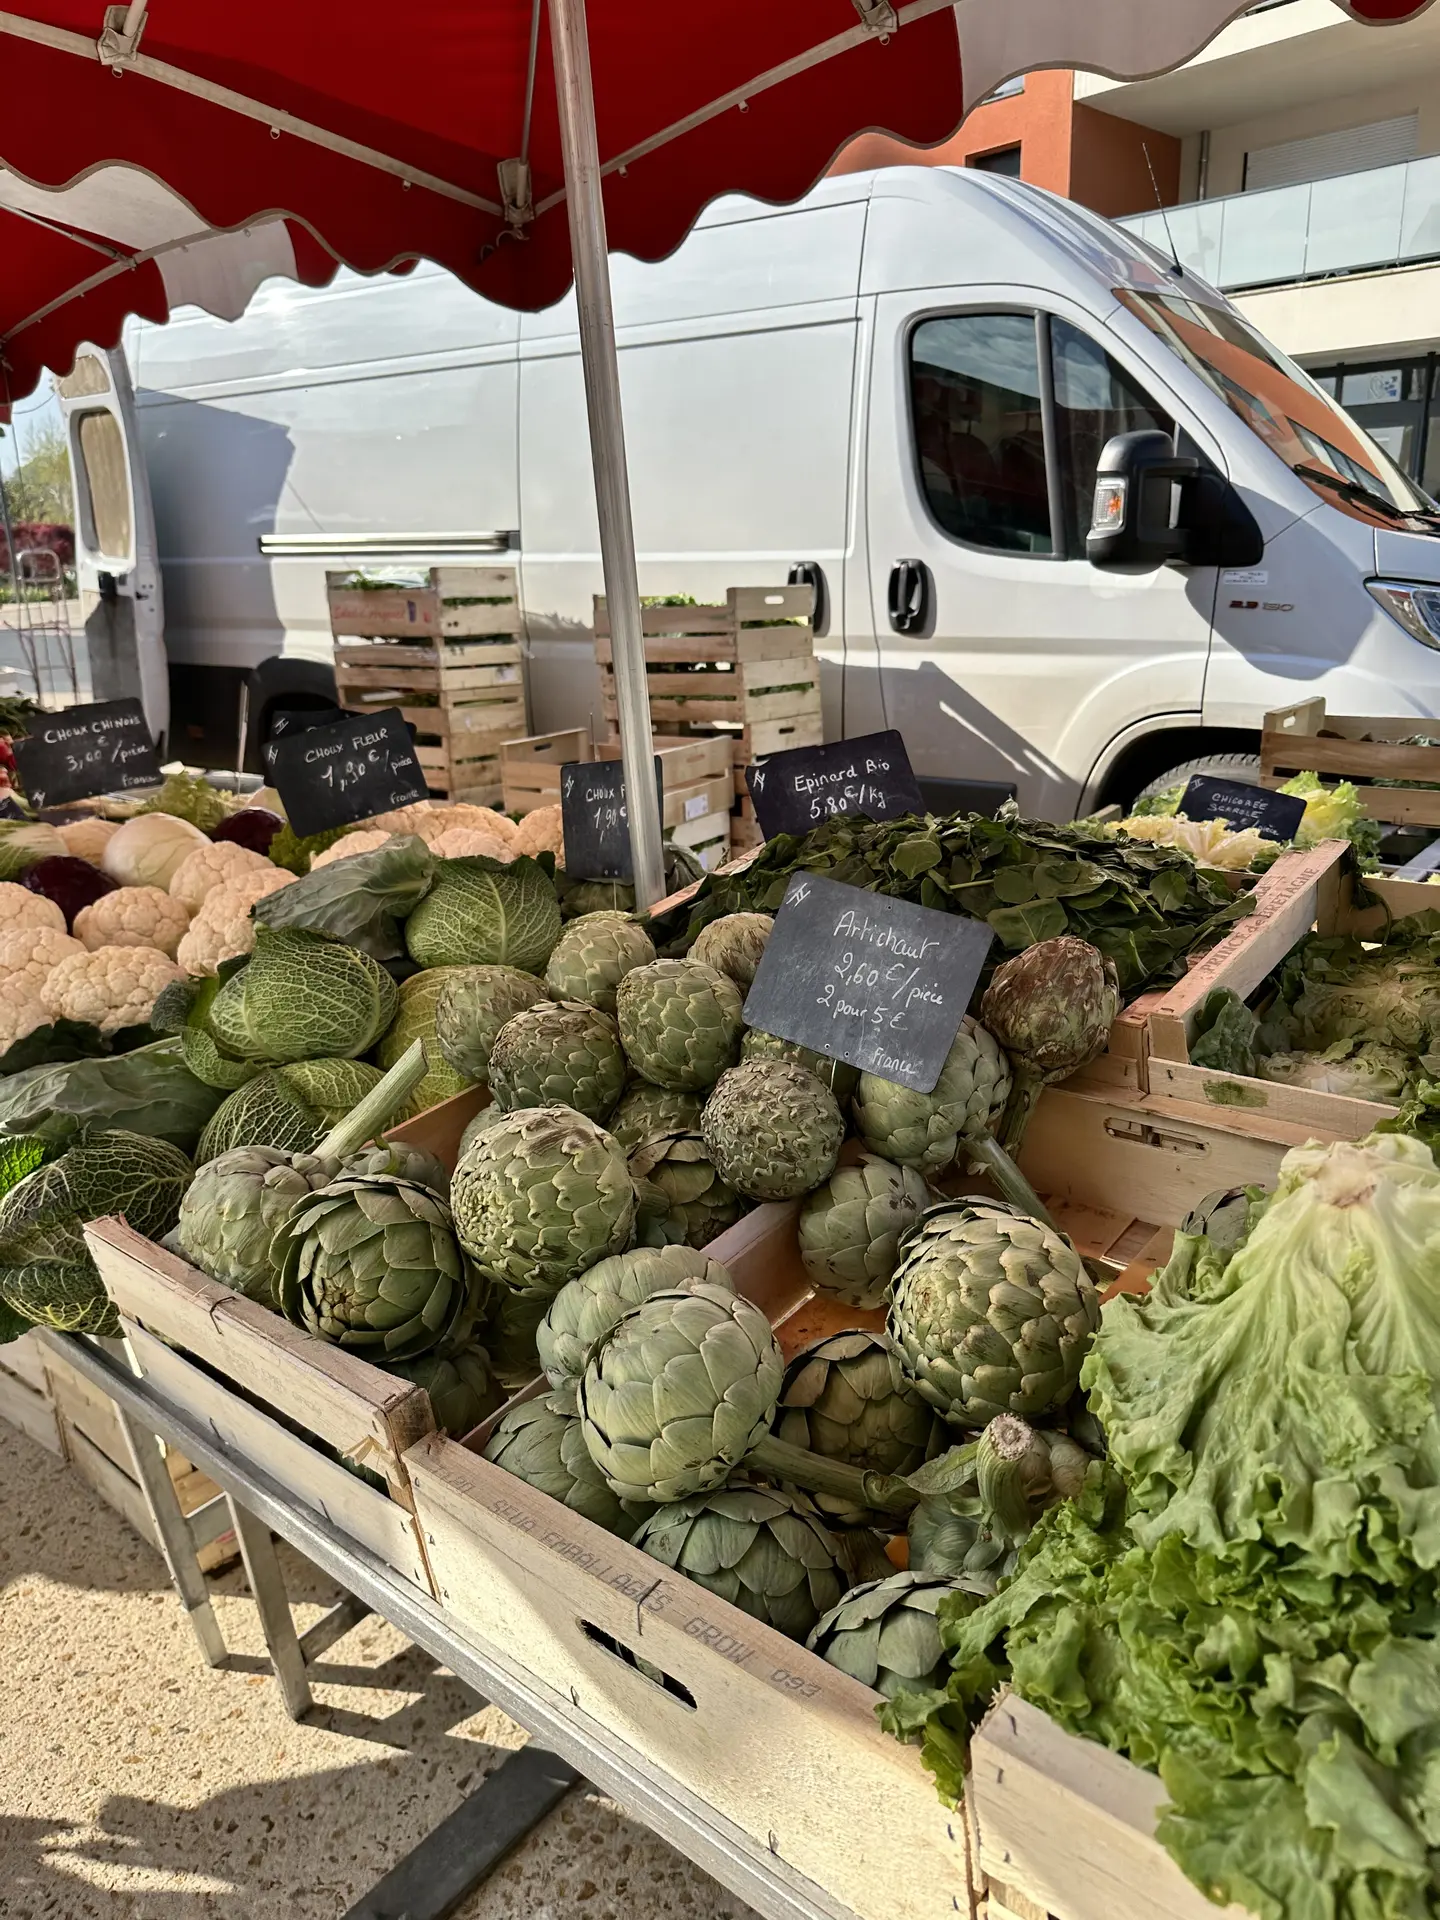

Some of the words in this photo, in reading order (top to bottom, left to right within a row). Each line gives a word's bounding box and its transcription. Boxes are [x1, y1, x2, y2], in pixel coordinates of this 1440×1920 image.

[44, 725, 88, 744] CHOUX
[91, 715, 141, 733] CHINOIS
[305, 743, 344, 763] CHOUX
[352, 727, 389, 750] FLEUR
[794, 765, 858, 794] Epinard
[866, 759, 890, 774] Bio
[585, 787, 615, 803] CHOUX
[1212, 792, 1268, 811] CHICORÉE
[833, 910, 940, 959] Artichaut
[1201, 930, 1250, 975] PRINCE
[1244, 918, 1265, 933] de
[1262, 866, 1320, 918] BRETAGNE
[816, 984, 834, 1008] 2
[833, 1000, 867, 1019] pour
[683, 1616, 755, 1664] GROW
[771, 1668, 821, 1698] 093
